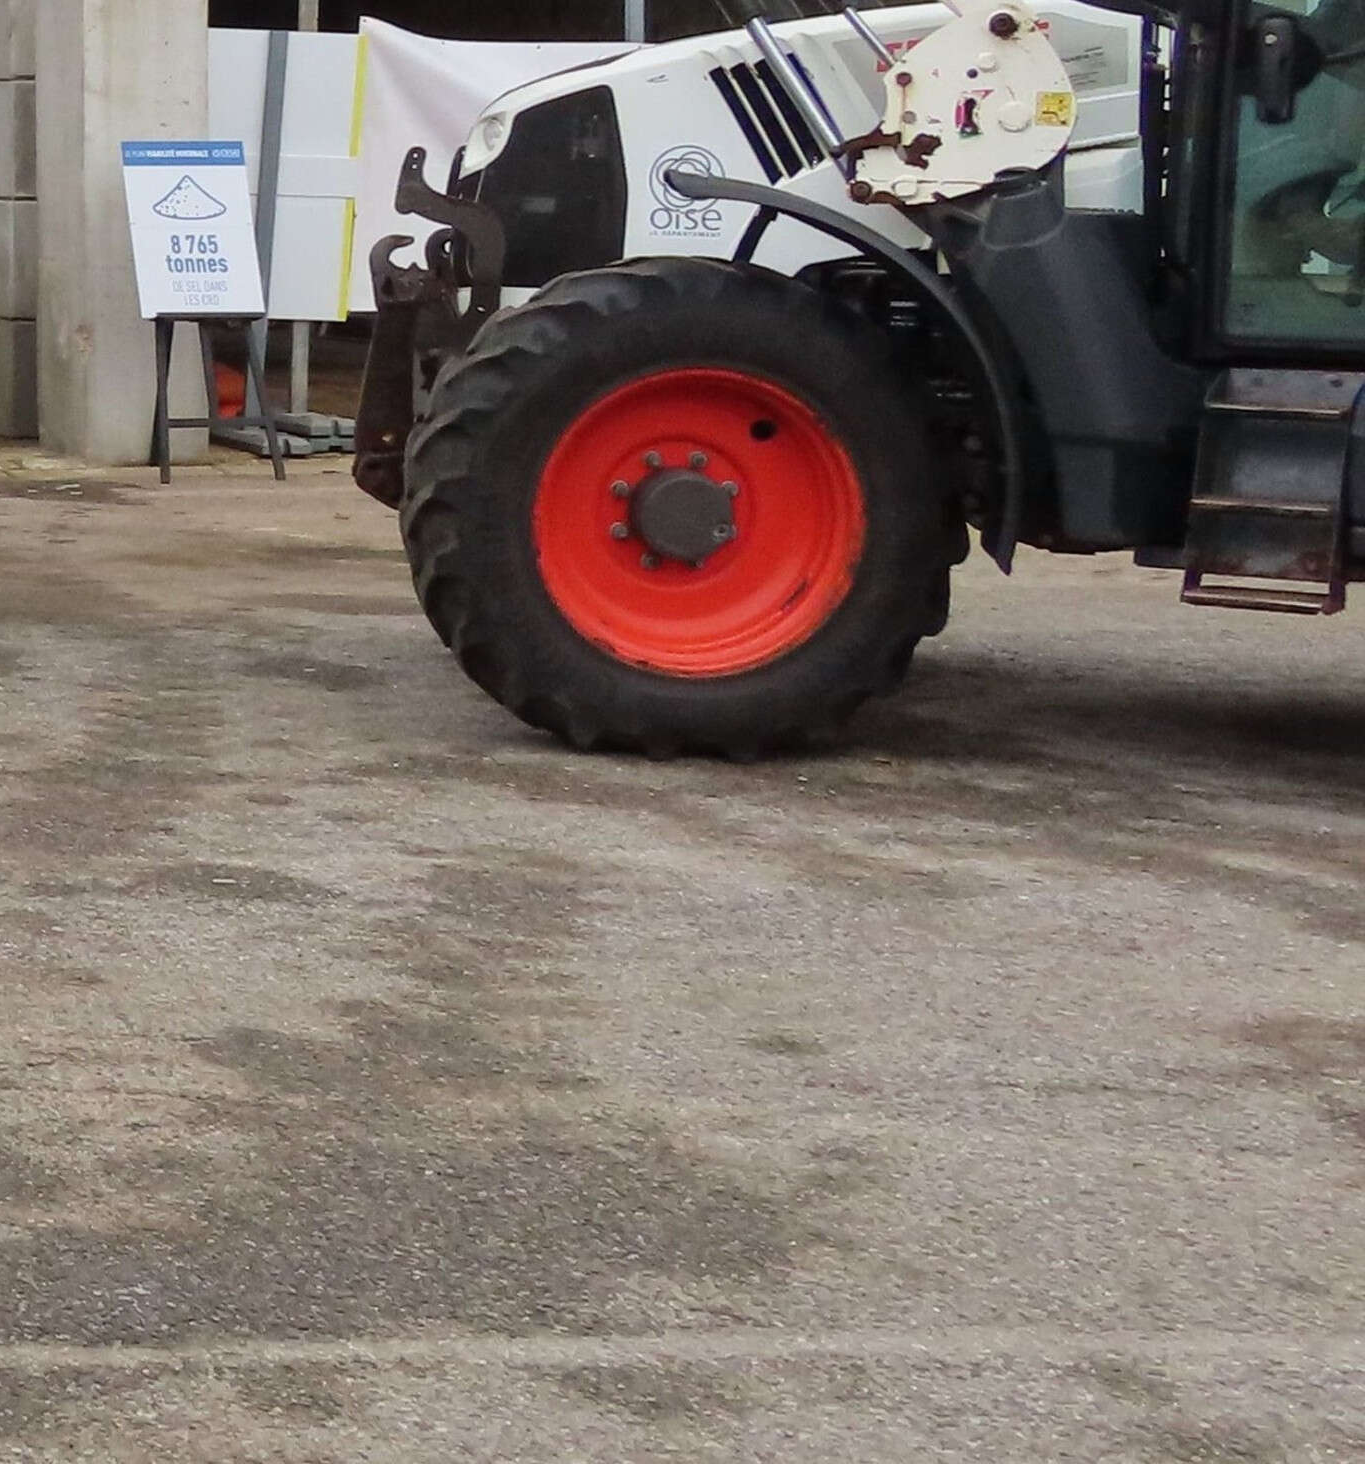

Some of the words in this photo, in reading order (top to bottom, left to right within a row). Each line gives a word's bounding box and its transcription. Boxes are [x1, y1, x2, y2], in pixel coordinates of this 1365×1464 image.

[170, 235, 181, 255] 8
[185, 235, 219, 255] 765
[165, 255, 229, 274] tonnes
[186, 280, 203, 293] SEL
[204, 280, 229, 293] DANS
[184, 294, 201, 307] LES
